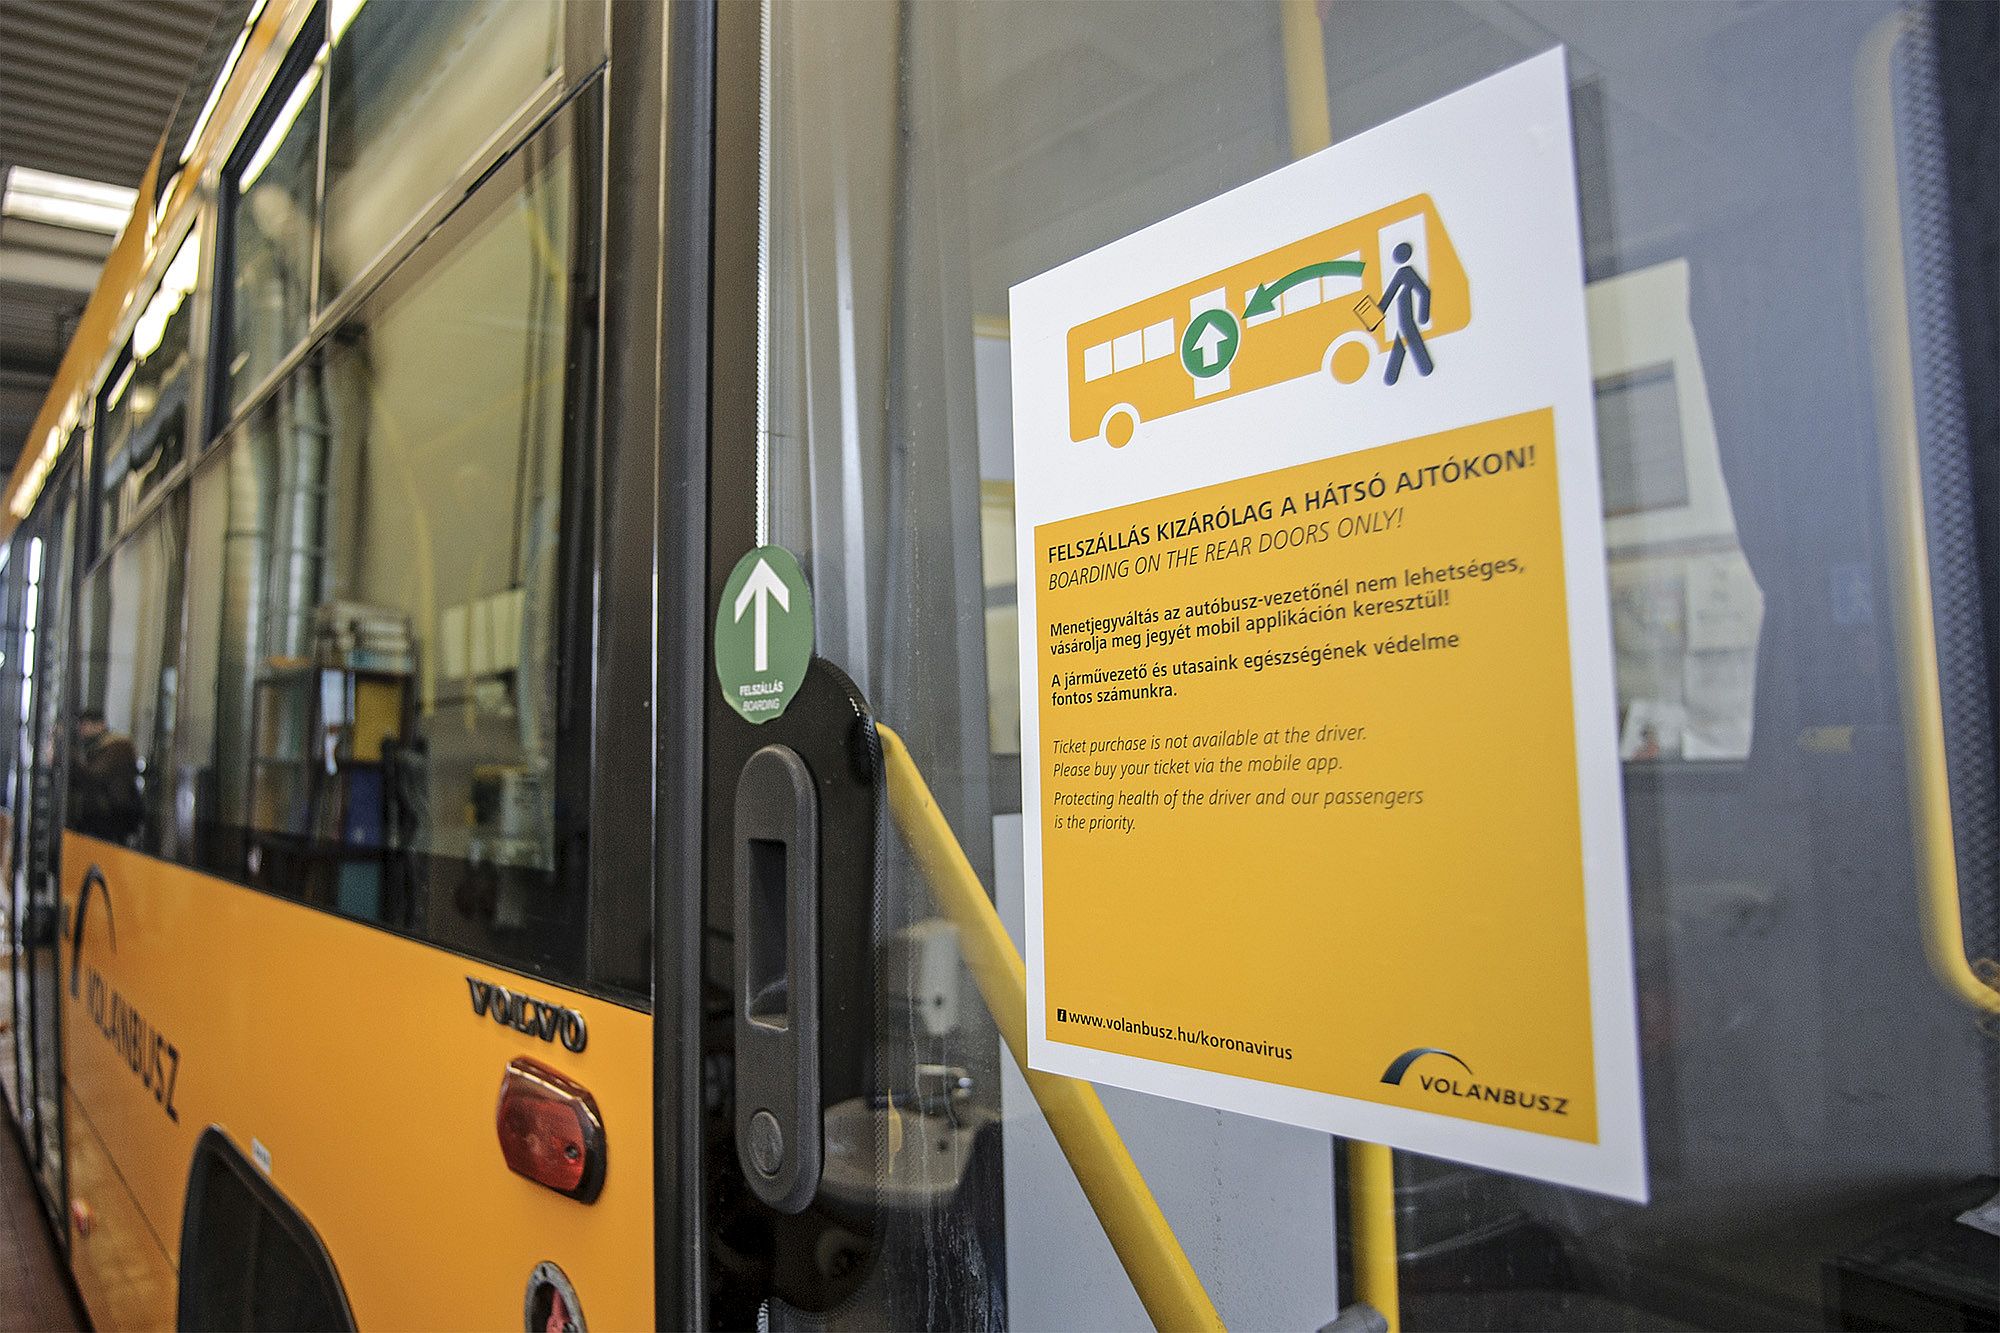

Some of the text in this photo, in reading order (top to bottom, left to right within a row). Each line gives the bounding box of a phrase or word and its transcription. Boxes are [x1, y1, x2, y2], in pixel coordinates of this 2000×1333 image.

[1049, 445, 1534, 563] FELSZÁLLÁS KIZÁRÓLAG A HÁTSÓ AJTÓKON!
[1049, 507, 1403, 590] BOARDING ON THE REAR DOORS ONLY!
[1050, 589, 1449, 655] vásárolja meg jegyét mobil applikáción keresztül!
[1051, 558, 1524, 637] Menetjegyváltás az autóbusz-vezetőnél nem lehetséges,
[1051, 633, 1459, 690] A járművezető és utasaink egészségének védelme
[1052, 683, 1177, 706] fontos számunkra.
[1053, 725, 1366, 756] Ticket purchase is not available at the driver.
[1053, 754, 1342, 780] Please buy your ticket via the mobile app.
[1054, 788, 1423, 809] Protecting health of the driver and our passengers
[1055, 815, 1135, 834] is the priority.
[465, 975, 588, 1053] VOLVO
[1068, 1011, 1293, 1060] www.volanbusz.hu/koronavirus
